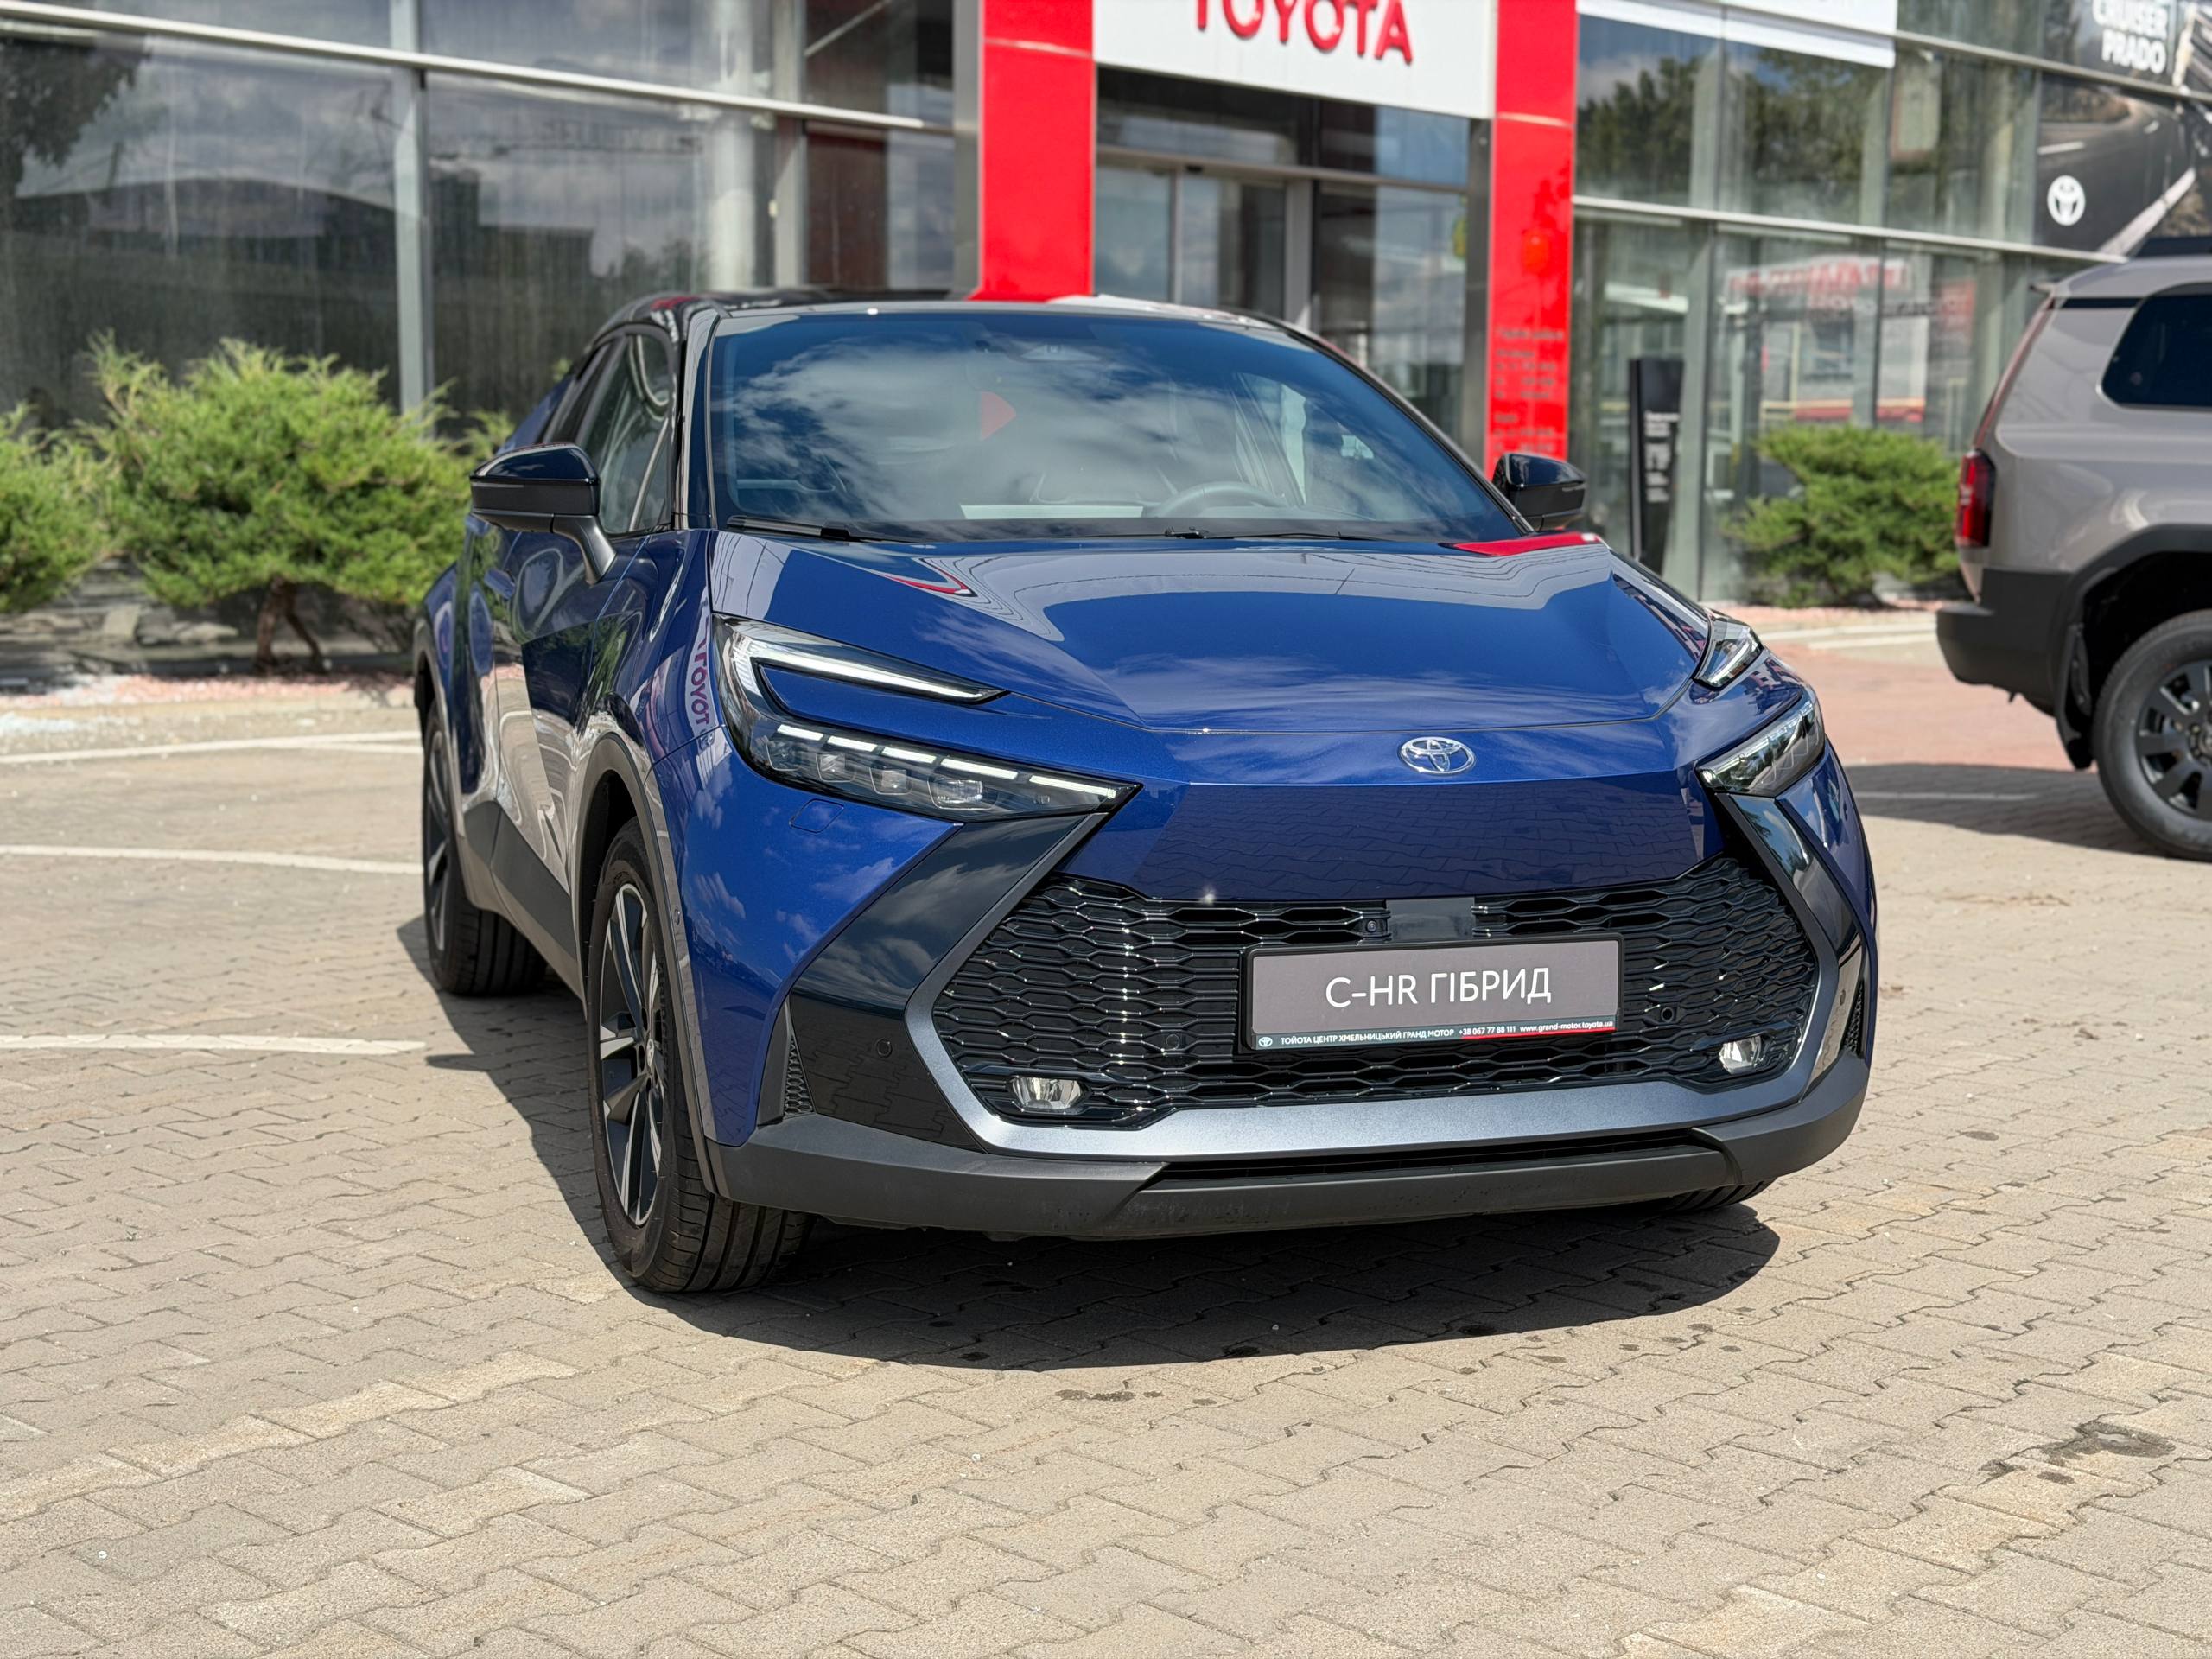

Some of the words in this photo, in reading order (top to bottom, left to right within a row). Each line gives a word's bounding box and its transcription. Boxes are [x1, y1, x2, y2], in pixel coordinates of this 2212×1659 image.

[2101, 28, 2166, 73] PRADO
[1325, 974, 1418, 1008] C-HR
[1430, 967, 1552, 1004] ГІБРИД
[1281, 1035, 1313, 1045] ТОЙОТА
[1313, 1035, 1338, 1045] ЦЕНТР
[1338, 1031, 1402, 1042] ХМЕЛЬНИЦЬКИЙ
[1403, 1030, 1427, 1039] ГРАНД
[1427, 1028, 1454, 1038] МОТОР
[1506, 1025, 1516, 1033] 111
[1520, 1020, 1614, 1033] www.grand-motor.toyota.ua
